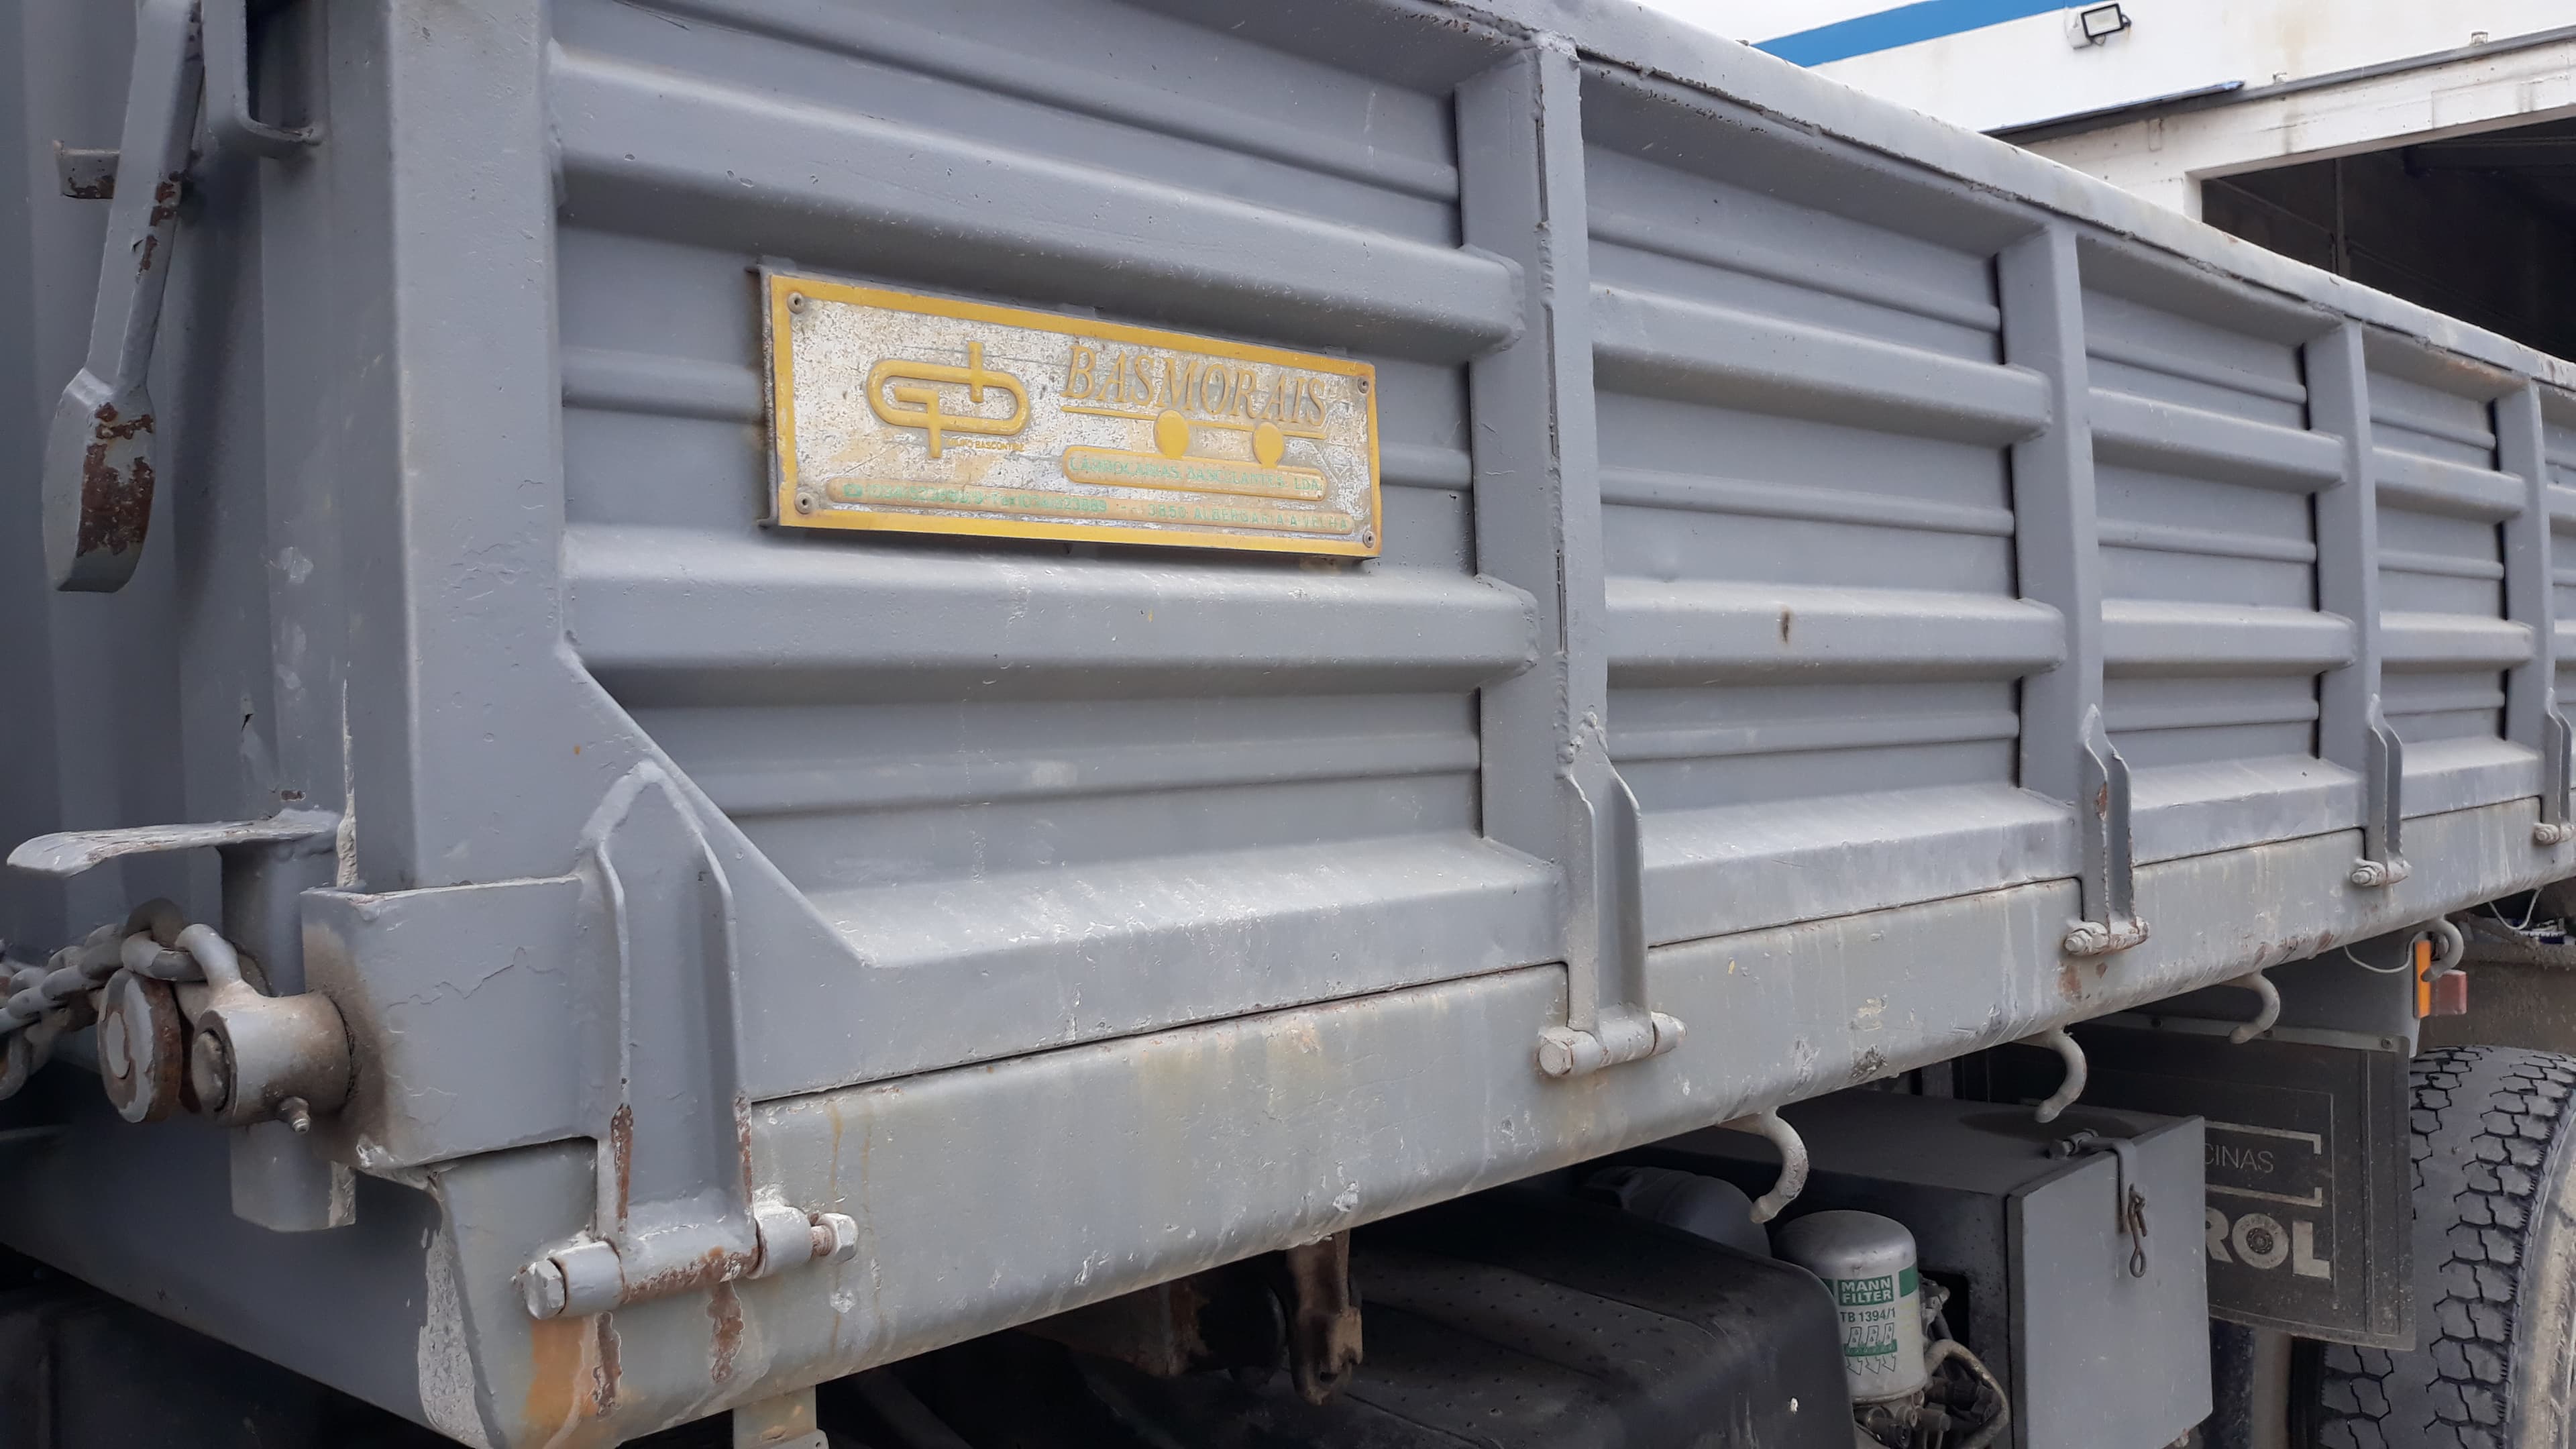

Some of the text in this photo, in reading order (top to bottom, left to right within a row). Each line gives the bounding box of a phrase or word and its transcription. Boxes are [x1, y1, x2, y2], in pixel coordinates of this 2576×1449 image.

[1060, 345, 1327, 427] BASMORAIS
[1148, 503, 1187, 519] 3850
[1841, 1277, 1891, 1293] MANN
[1842, 1289, 1892, 1303] FILTER
[1839, 1307, 1896, 1323] TB 1394/1
